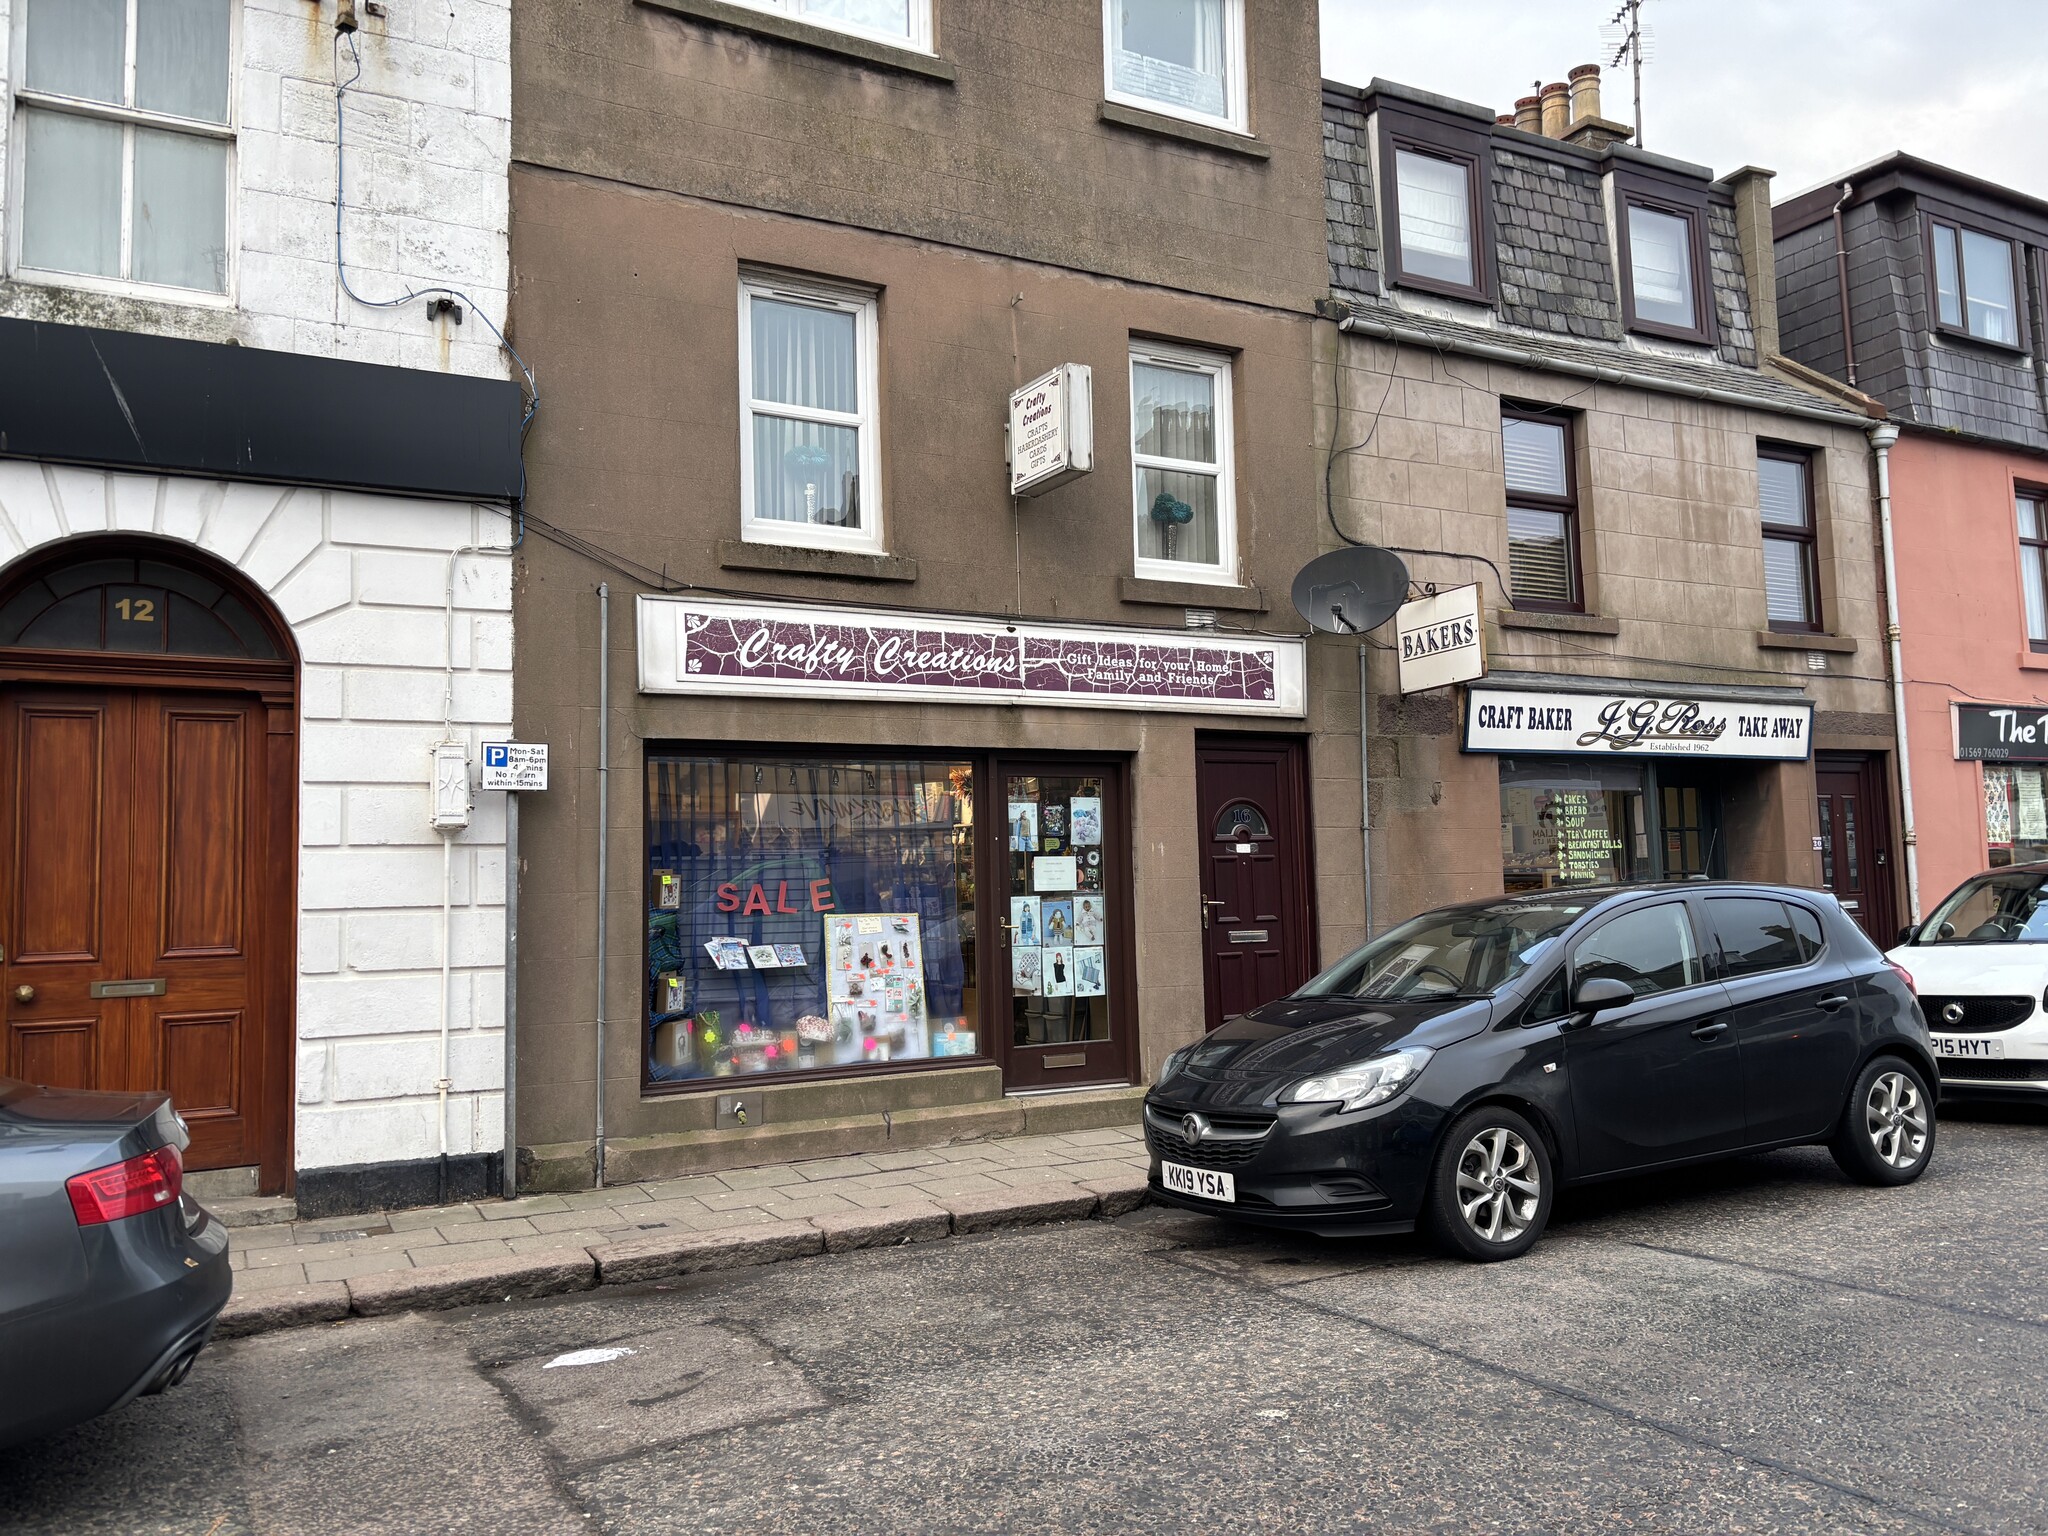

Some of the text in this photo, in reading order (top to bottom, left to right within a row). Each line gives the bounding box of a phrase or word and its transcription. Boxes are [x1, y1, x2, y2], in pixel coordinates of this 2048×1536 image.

[1026, 392, 1046, 410] Crafty
[1022, 404, 1052, 426] Creations
[1027, 422, 1048, 439] CRAFTS
[1017, 427, 1059, 455] HABERDASHERY
[1029, 444, 1047, 459] CARDS
[1031, 455, 1046, 469] GIFTS
[115, 598, 154, 622] 12
[1402, 618, 1474, 659] BAKERS
[740, 628, 1017, 675] Crafty Creations
[1067, 653, 1092, 665] Gift
[1099, 655, 1133, 668] Ideas
[1139, 658, 1157, 669] for
[1163, 661, 1190, 671] your
[1087, 668, 1214, 685] Family and Friends
[1478, 704, 1572, 731] CRAFT BAKER
[1988, 709, 2036, 743] The
[1738, 715, 1803, 739] TAKE AWAY
[1650, 742, 1709, 752] Established 1962
[508, 756, 547, 764] 8am-6pm
[1563, 795, 1588, 804] CAKES
[1233, 808, 1252, 823] 16
[1565, 806, 1587, 815] BREAD
[1565, 817, 1585, 827] SOUP
[1568, 839, 1623, 849] BREAKFAST ROLLS
[716, 878, 835, 916] SALE
[1958, 1040, 1991, 1055] HYT
[1168, 1165, 1225, 1197] KK19 YSA
